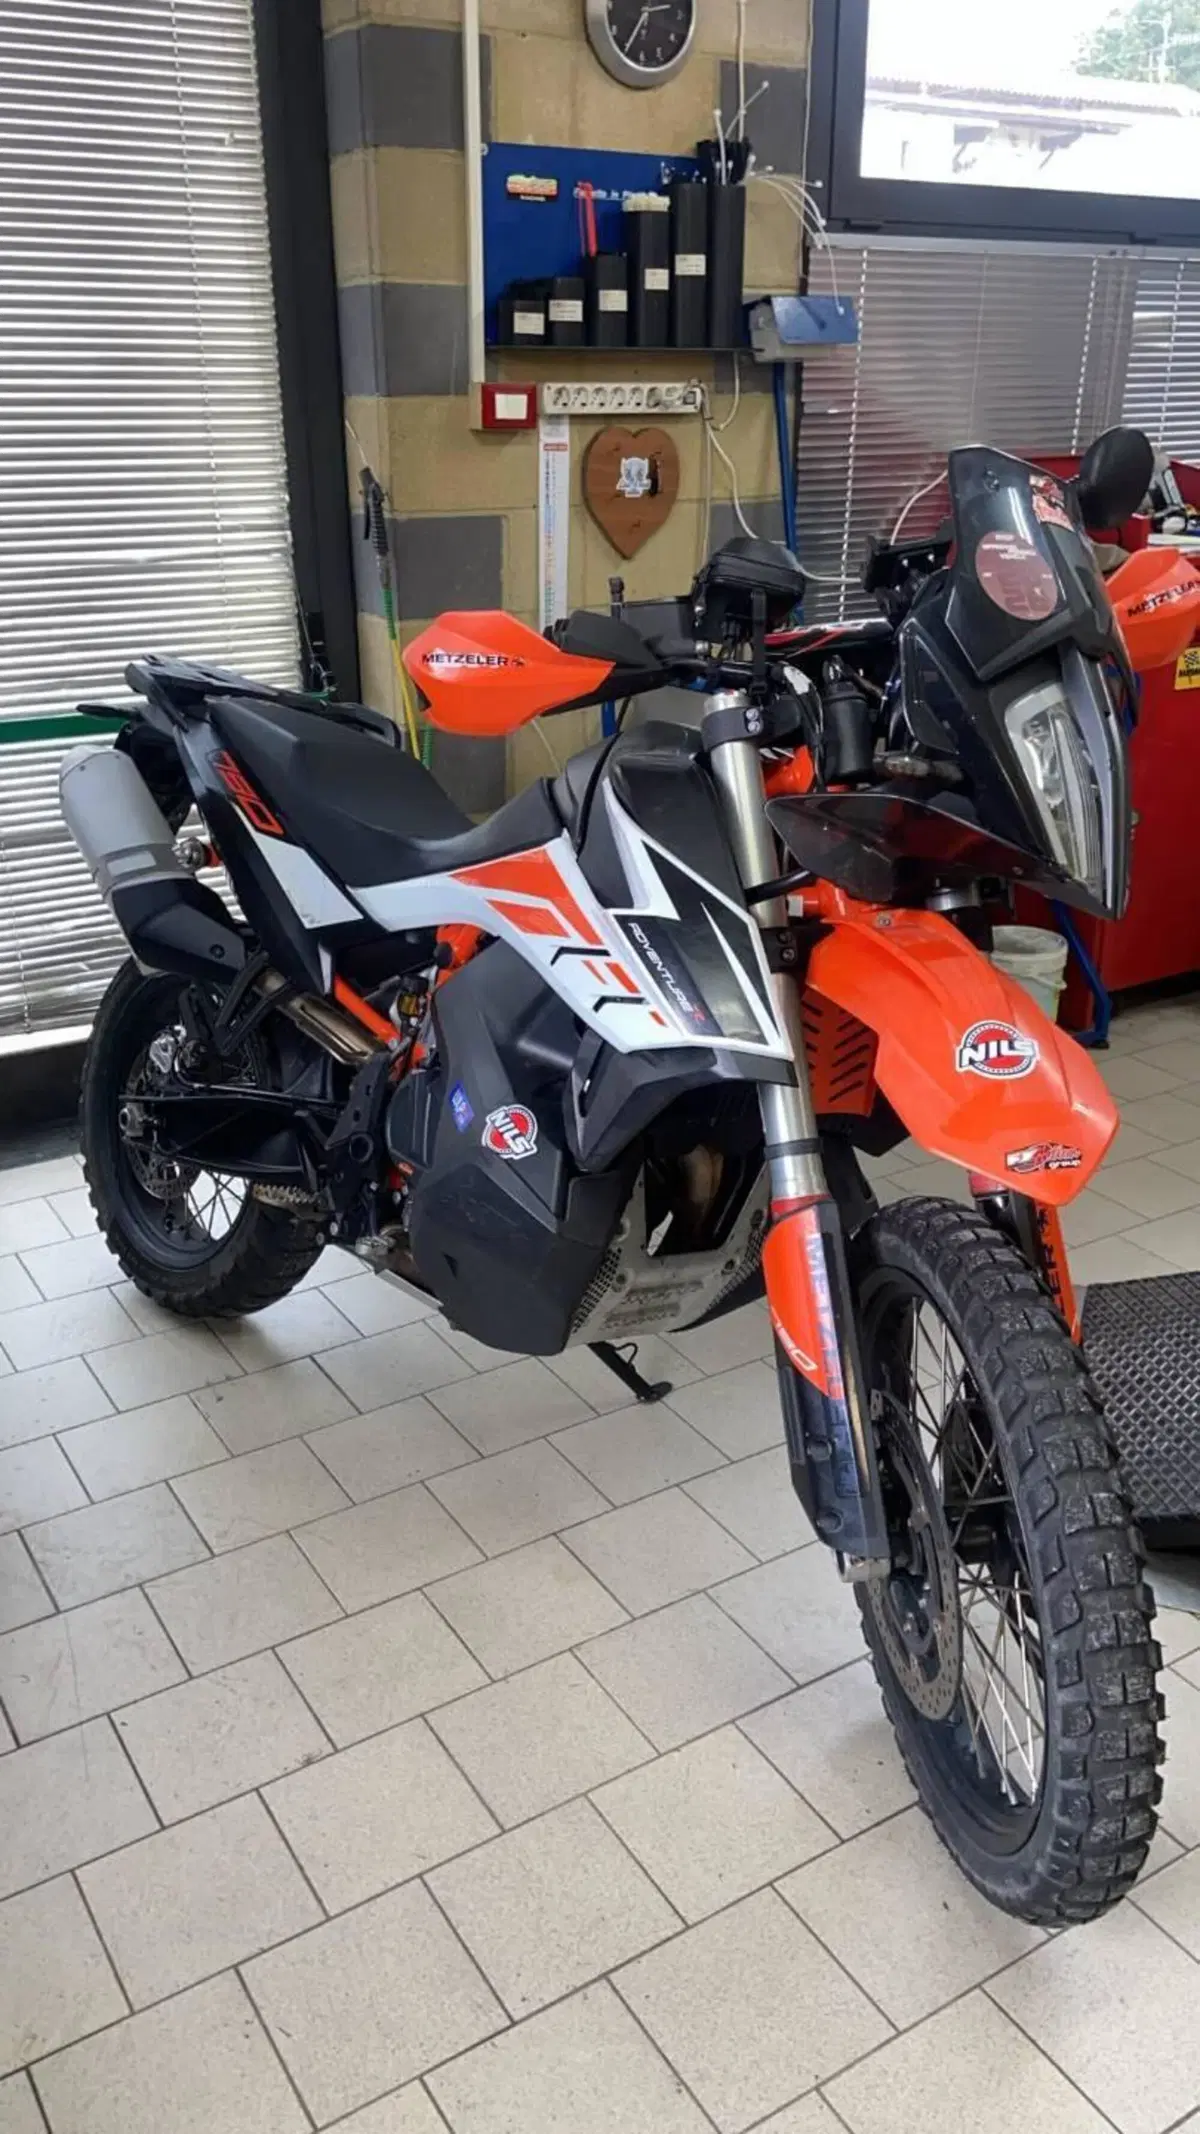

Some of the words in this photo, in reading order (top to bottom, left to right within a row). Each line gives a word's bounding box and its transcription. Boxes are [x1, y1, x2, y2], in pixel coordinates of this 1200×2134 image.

[421, 653, 509, 666] METZELER
[212, 750, 284, 836] 790
[628, 922, 693, 1013] ADVENTURE
[959, 1040, 1036, 1067] NILS
[490, 1109, 531, 1154] NILS
